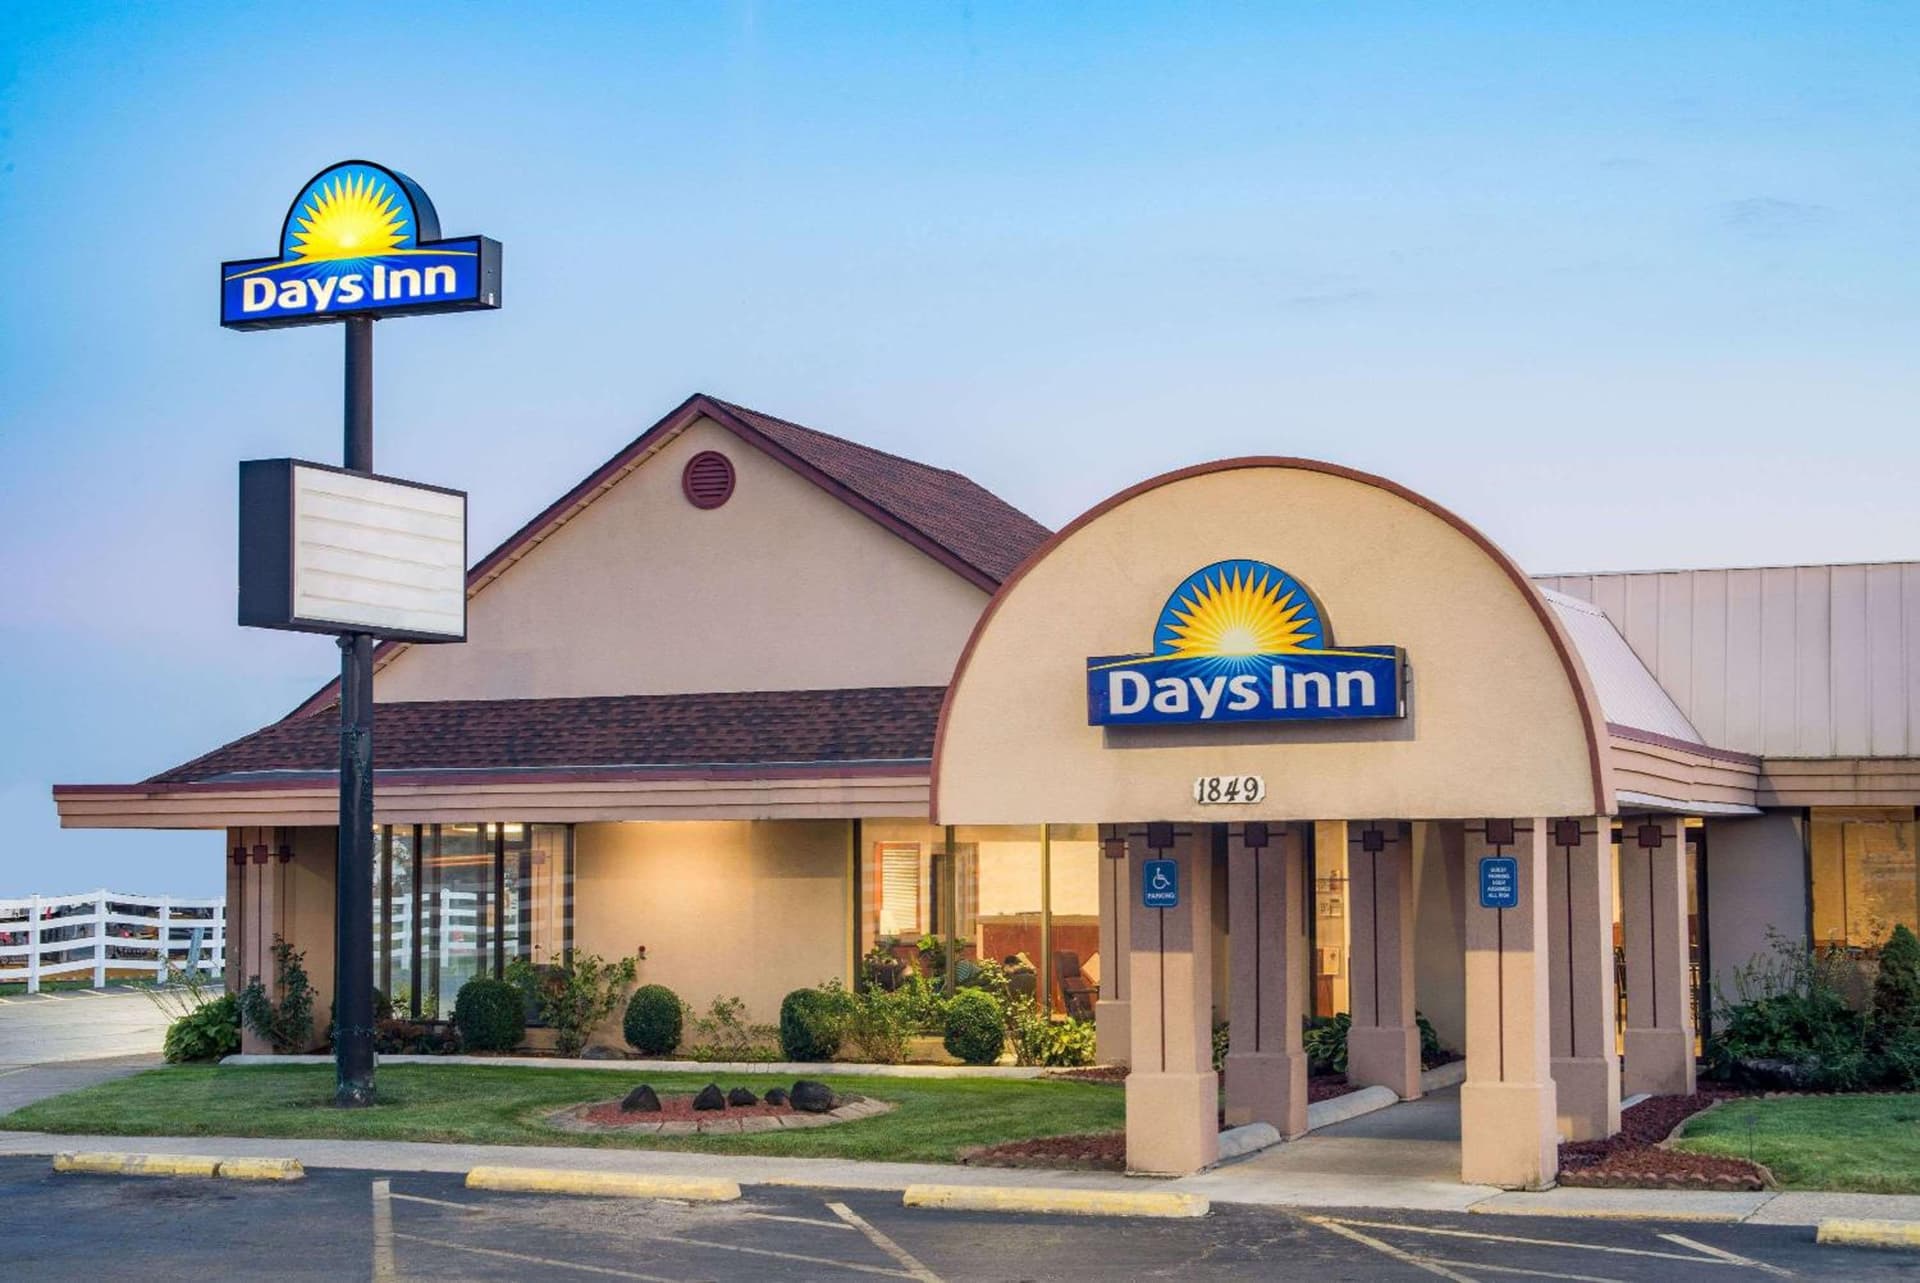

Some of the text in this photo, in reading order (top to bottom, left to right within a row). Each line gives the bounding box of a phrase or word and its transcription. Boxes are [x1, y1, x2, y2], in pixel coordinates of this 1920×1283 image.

[242, 264, 457, 313] Days Inn
[1109, 666, 1376, 719] Days Inn
[1199, 777, 1259, 801] 1849
